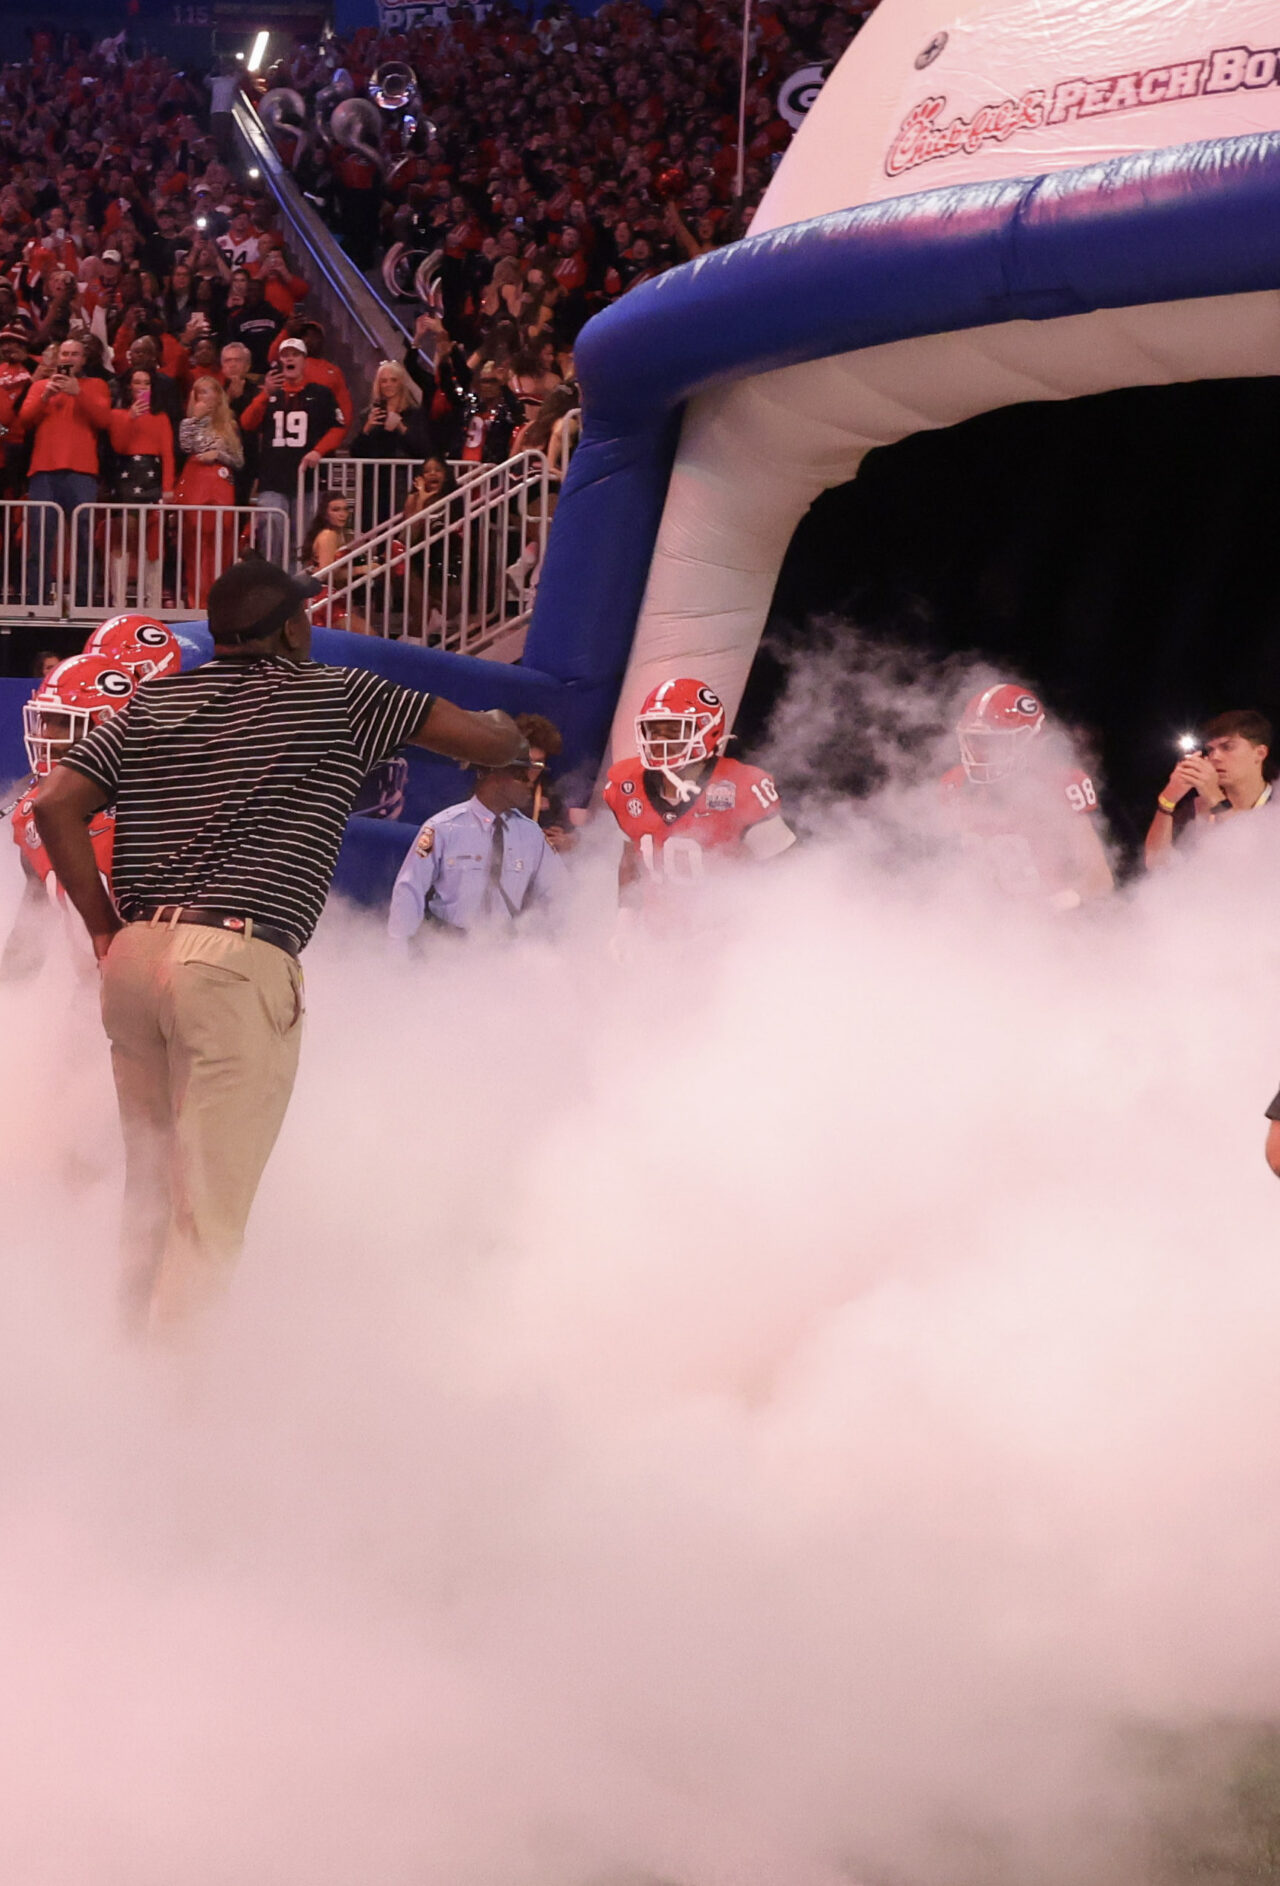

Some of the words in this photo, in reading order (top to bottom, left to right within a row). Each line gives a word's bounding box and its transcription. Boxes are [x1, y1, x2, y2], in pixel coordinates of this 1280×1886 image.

[1049, 60, 1204, 124] PEACH
[1204, 46, 1280, 95] BO
[272, 411, 308, 448] 19
[751, 777, 779, 809] 10
[1065, 777, 1097, 812] 98
[640, 833, 703, 885] 10
